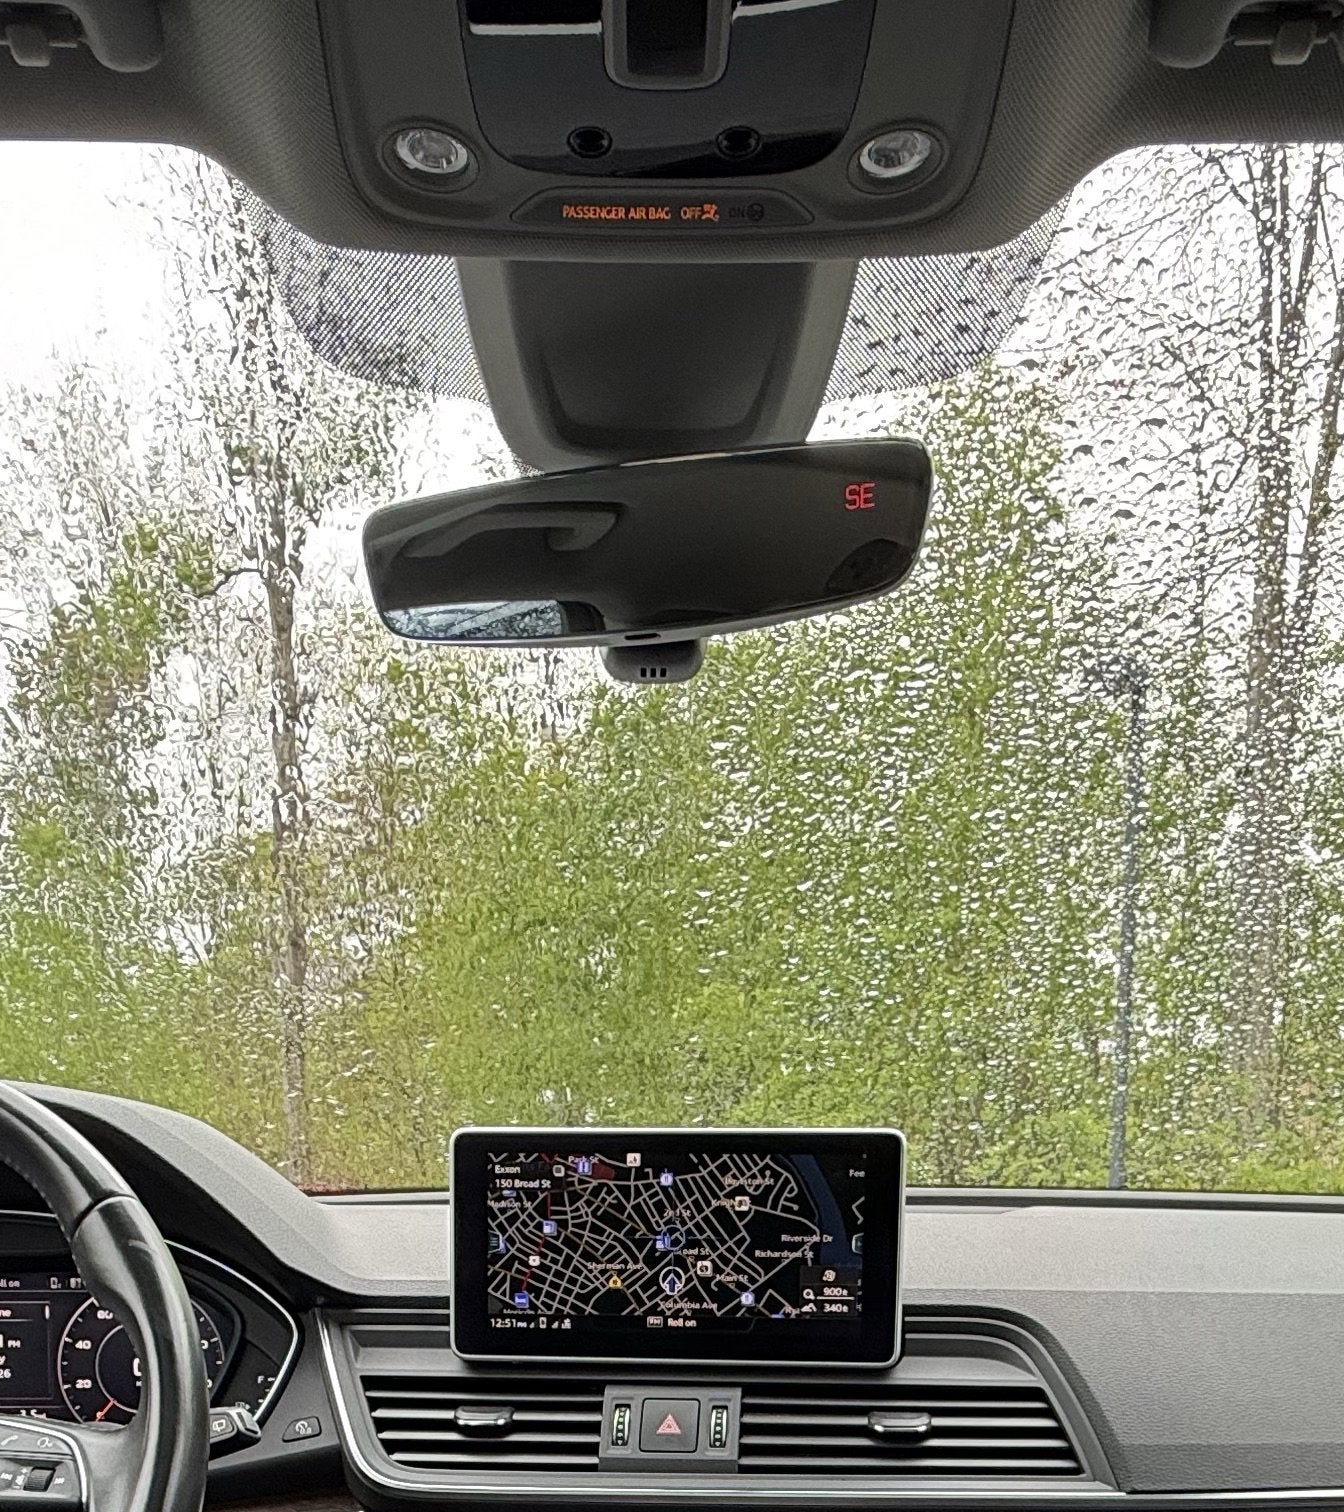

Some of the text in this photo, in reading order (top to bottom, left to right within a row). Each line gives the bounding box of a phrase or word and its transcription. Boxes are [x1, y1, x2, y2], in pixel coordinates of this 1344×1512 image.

[562, 205, 672, 220] PASSENGER AIR BAG
[680, 208, 703, 220] OFF
[845, 482, 876, 510] SE
[495, 1179, 552, 1188] 150 Broad St
[781, 1234, 834, 1243] Riverside Dr
[755, 1250, 802, 1258] Richardson
[587, 1262, 625, 1270] Sherman
[716, 1274, 749, 1282] Main St
[660, 1301, 700, 1310] Columbia
[667, 1319, 683, 1328] Roll
[7, 1340, 21, 1349] PM
[74, 1339, 92, 1350] 40
[75, 1379, 92, 1389] 20
[257, 1375, 265, 1384] F
